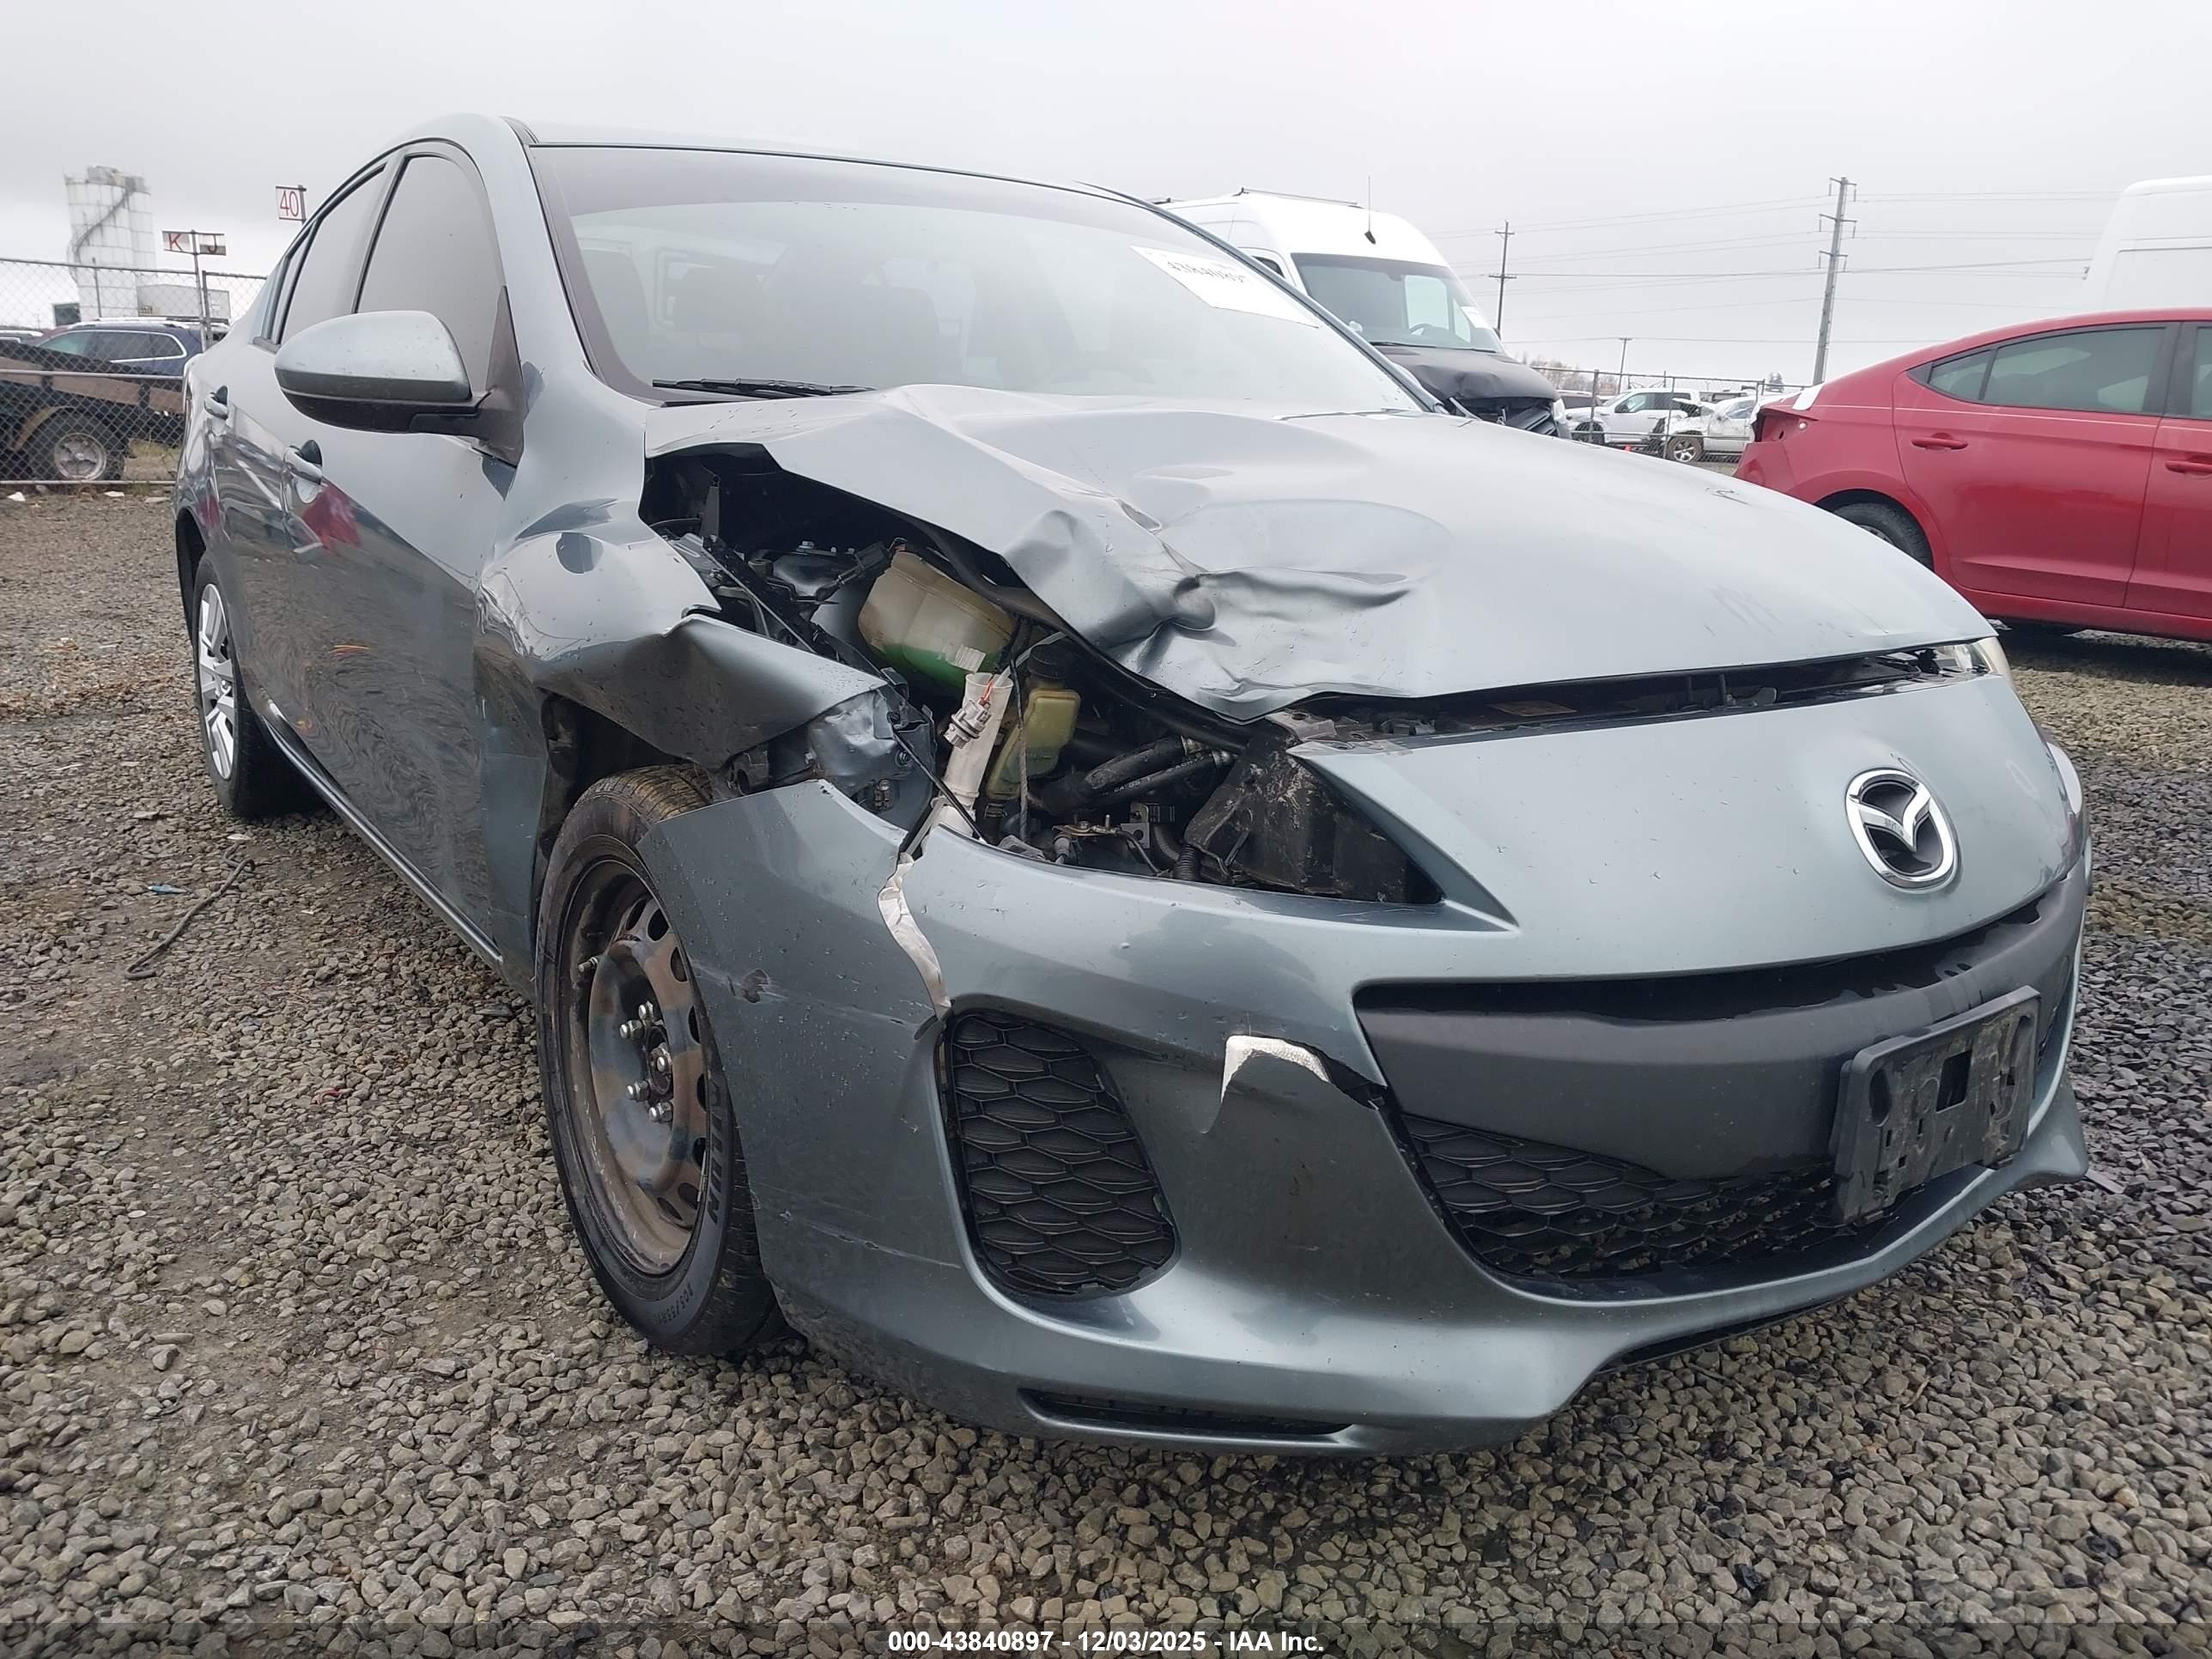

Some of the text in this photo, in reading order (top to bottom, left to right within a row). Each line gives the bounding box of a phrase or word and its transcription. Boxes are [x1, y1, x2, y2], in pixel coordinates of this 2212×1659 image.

[280, 190, 299, 217] 40
[168, 234, 184, 252] K
[207, 234, 218, 253] J
